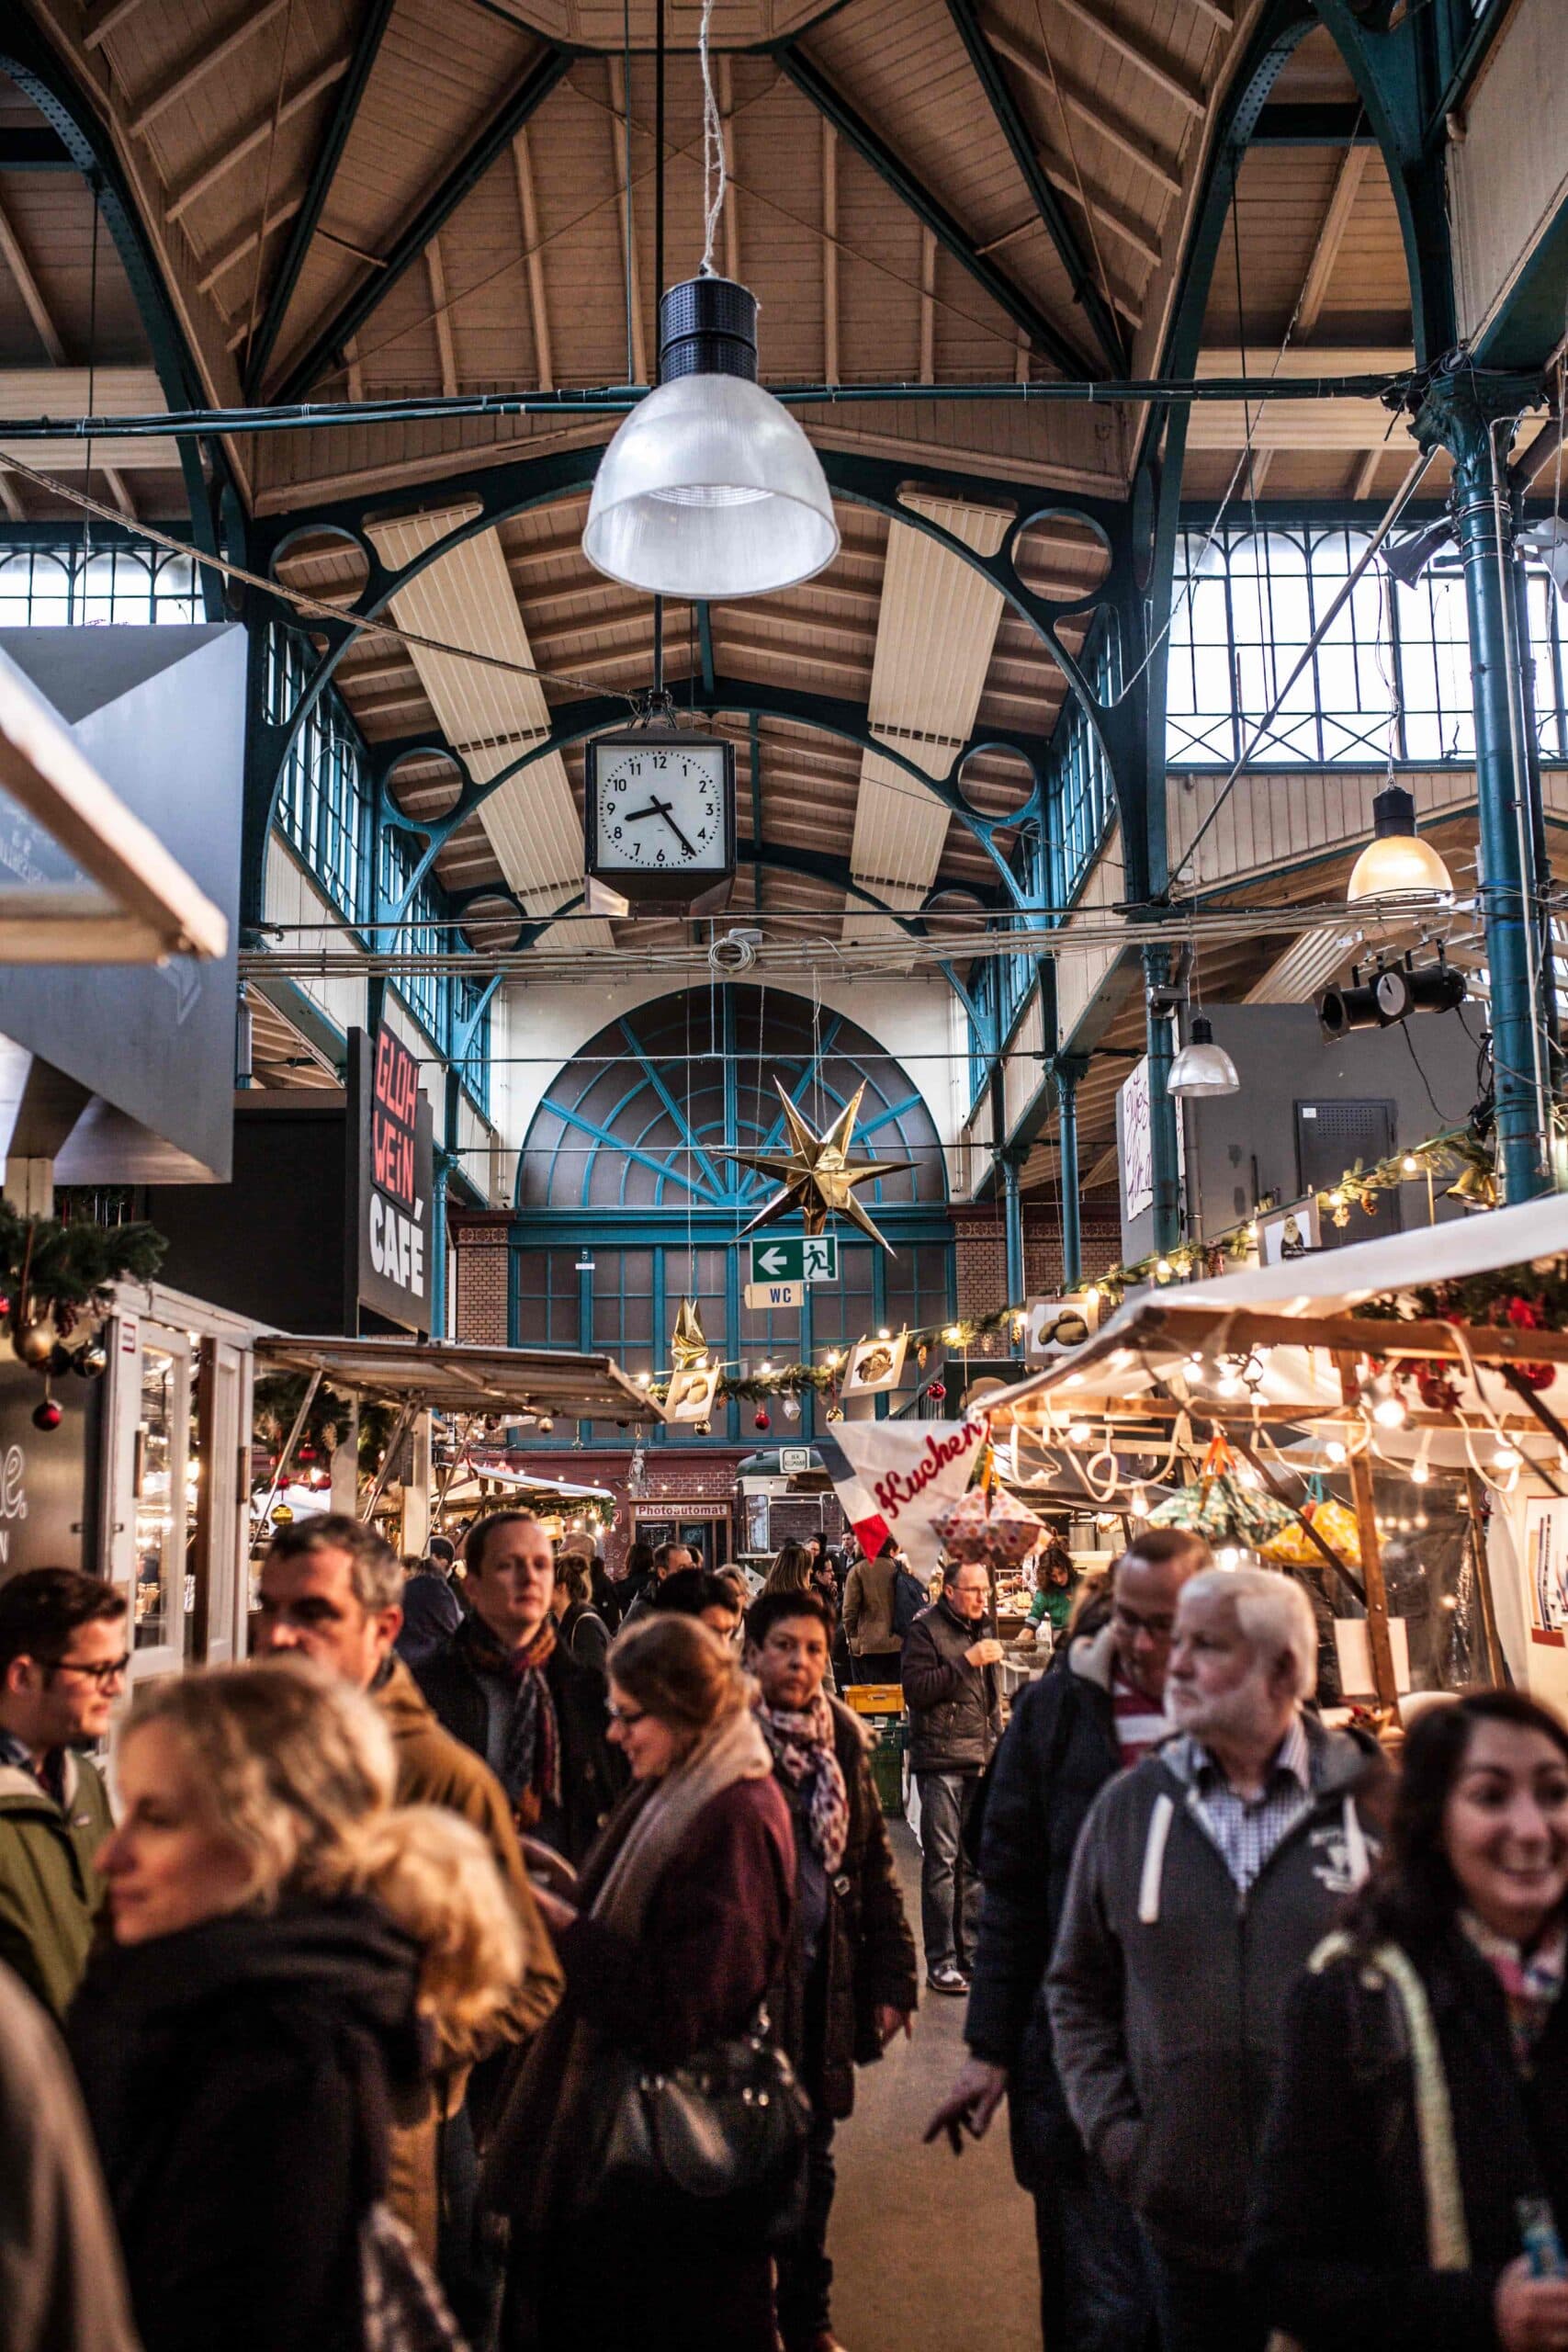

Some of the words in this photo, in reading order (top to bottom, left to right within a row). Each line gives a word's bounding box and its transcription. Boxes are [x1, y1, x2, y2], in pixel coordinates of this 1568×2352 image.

[629, 763, 641, 775] 11
[652, 756, 667, 769] 12
[682, 764, 688, 776] 1
[613, 778, 626, 792] 10
[699, 780, 707, 793] 2
[606, 802, 615, 815] 9
[705, 803, 714, 816] 3
[614, 827, 622, 839] 8
[697, 827, 705, 840] 4
[633, 842, 641, 856] 7
[656, 849, 665, 862] 6
[681, 843, 690, 855] 5
[369, 1193, 424, 1298] CAFÉ
[770, 1287, 792, 1303] WC
[874, 1421, 983, 1521] Kuchen
[638, 1505, 724, 1515] Photoautomat
